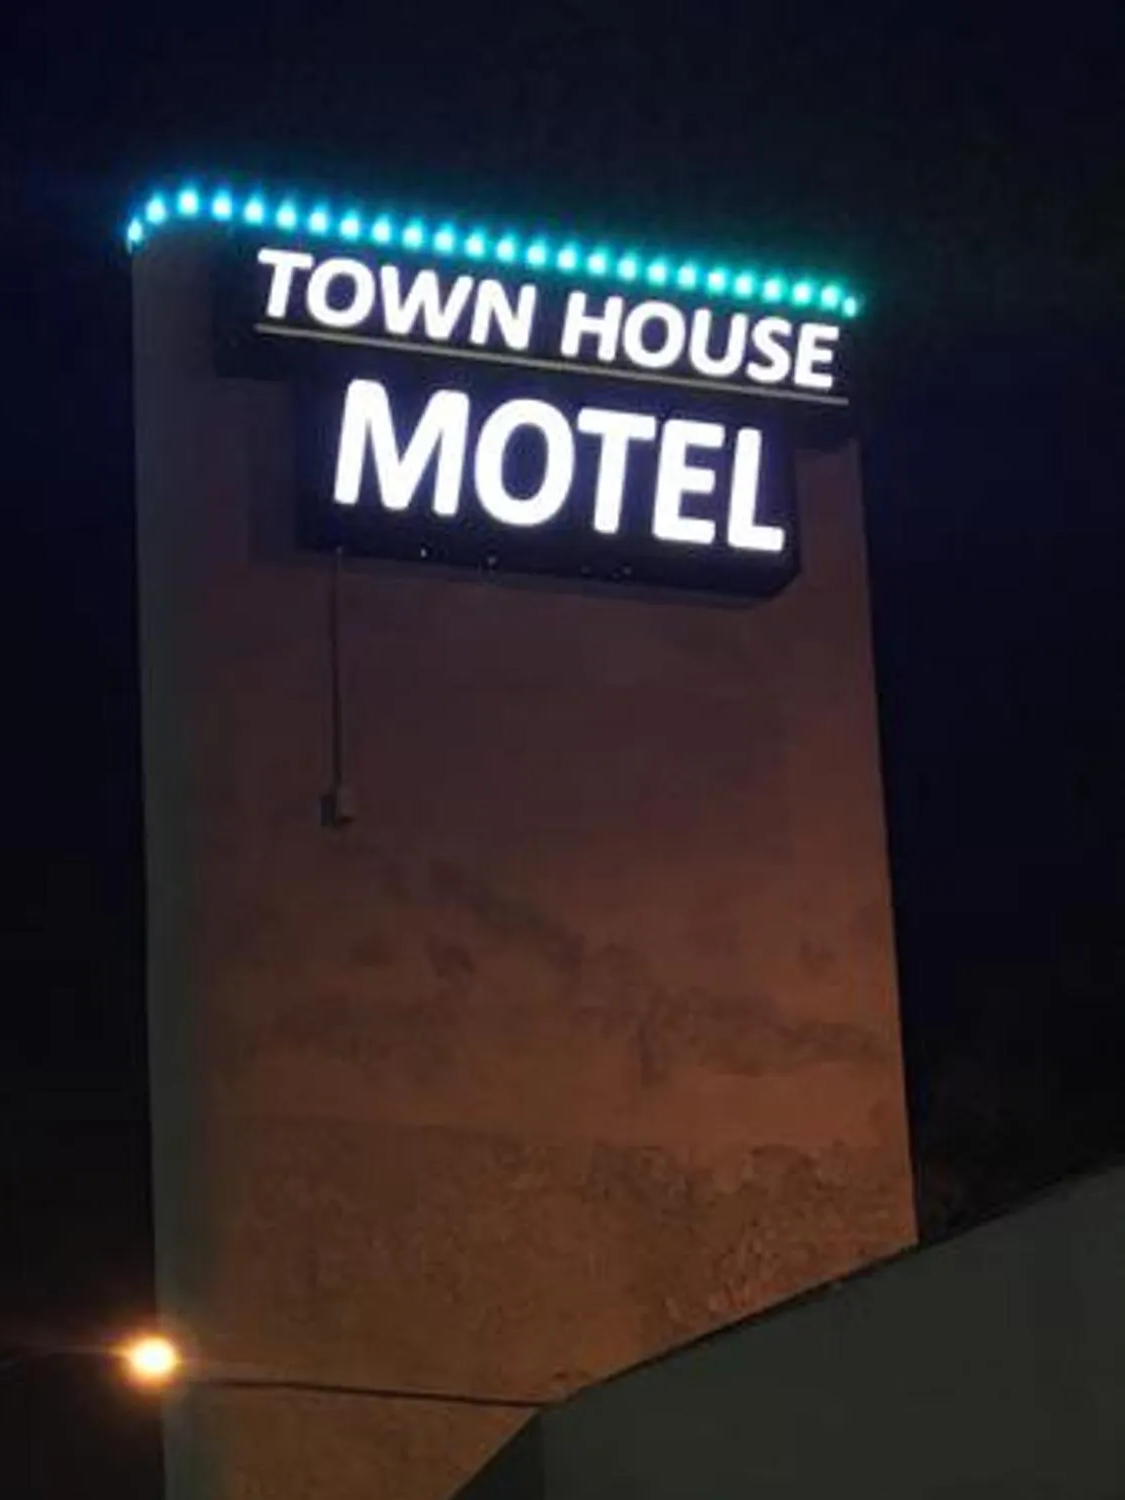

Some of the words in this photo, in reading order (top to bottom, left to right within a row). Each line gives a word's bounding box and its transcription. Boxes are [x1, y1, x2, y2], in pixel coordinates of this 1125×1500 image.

[257, 248, 537, 350] TOWN
[560, 291, 840, 389] HOUSE
[333, 378, 786, 553] MOTEL
